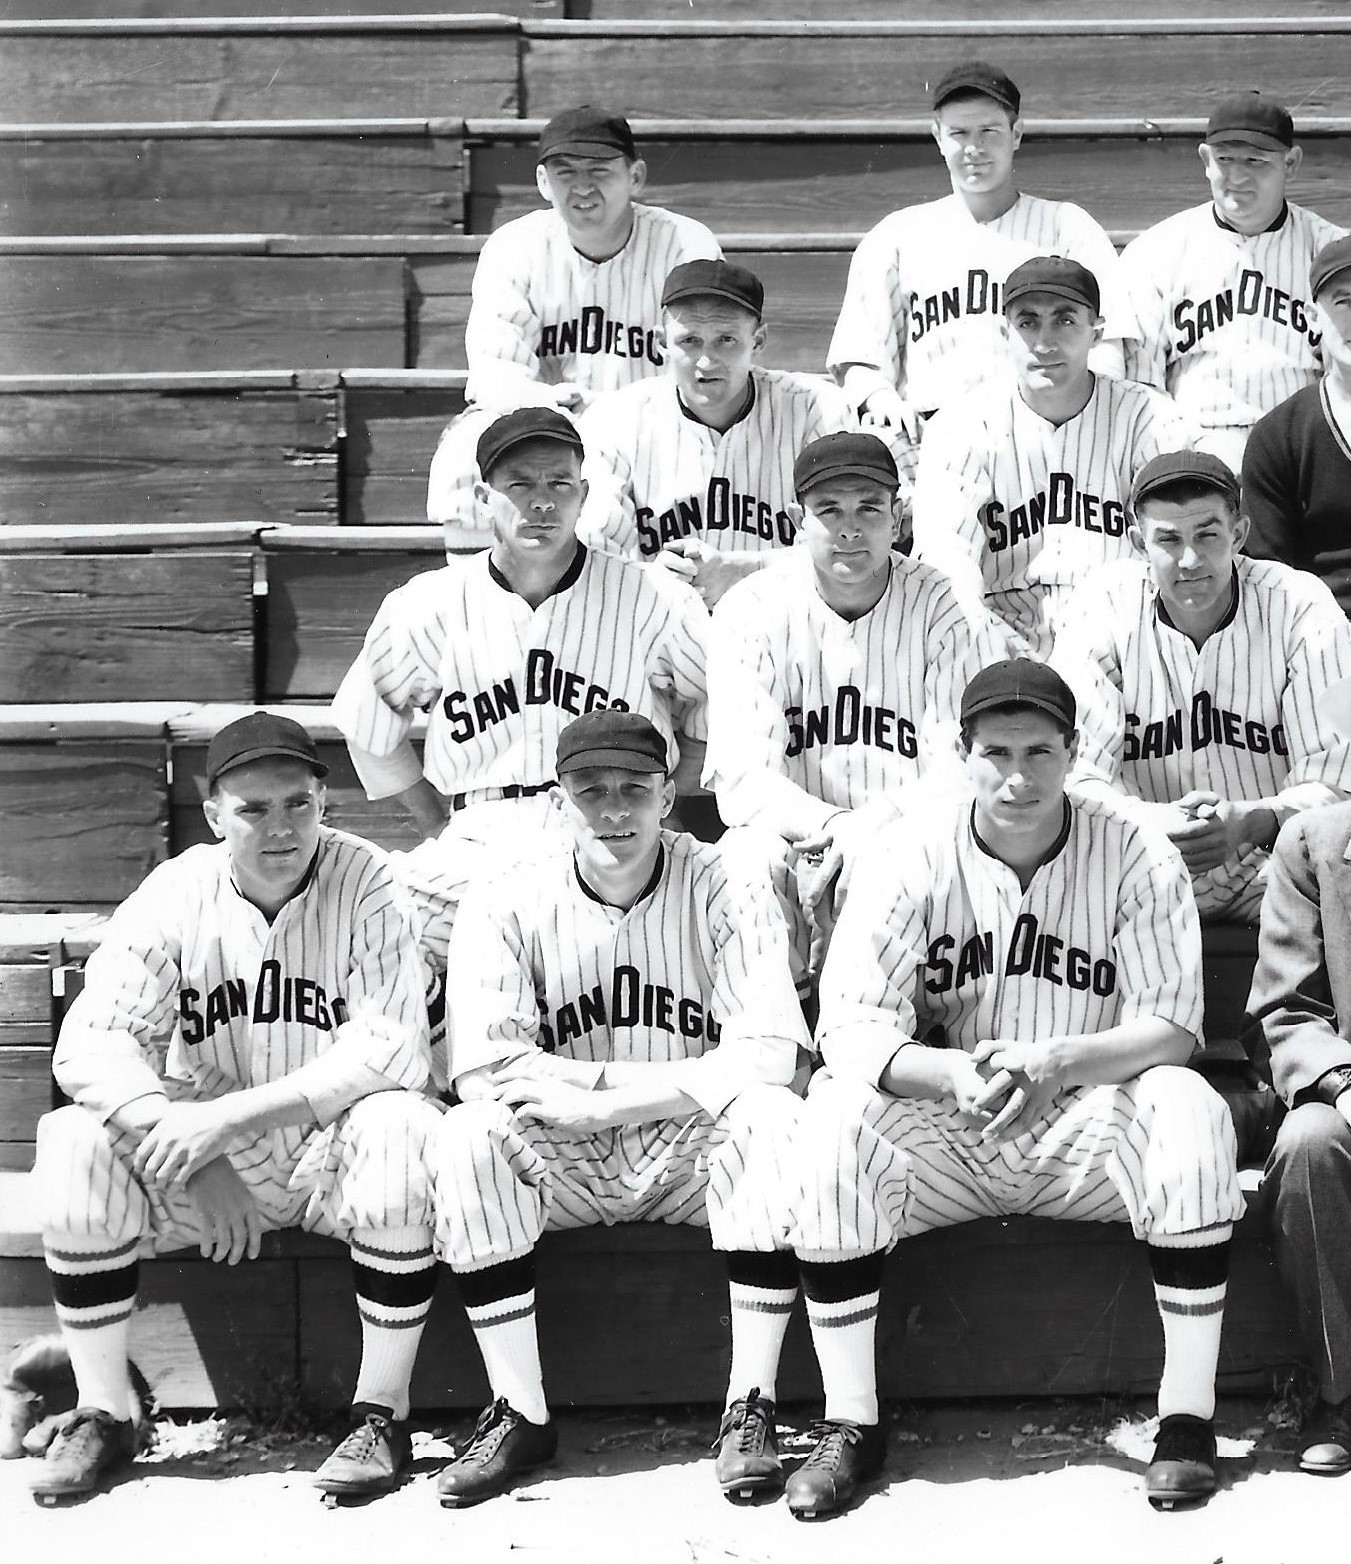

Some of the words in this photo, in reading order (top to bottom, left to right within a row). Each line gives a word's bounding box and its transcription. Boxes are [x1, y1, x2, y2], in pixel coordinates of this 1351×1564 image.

[535, 318, 580, 358] AN
[910, 286, 960, 342] SAN
[1174, 289, 1233, 353] SAN
[637, 496, 703, 555] SAN
[706, 477, 797, 546] DIEGO
[987, 491, 1046, 552] SAN
[1048, 473, 1130, 538] DIEG
[444, 678, 519, 743] SAN
[1123, 710, 1183, 761] SAN
[926, 932, 993, 994] SAN
[1005, 913, 1116, 996] DIEGO
[180, 979, 248, 1045] SAN
